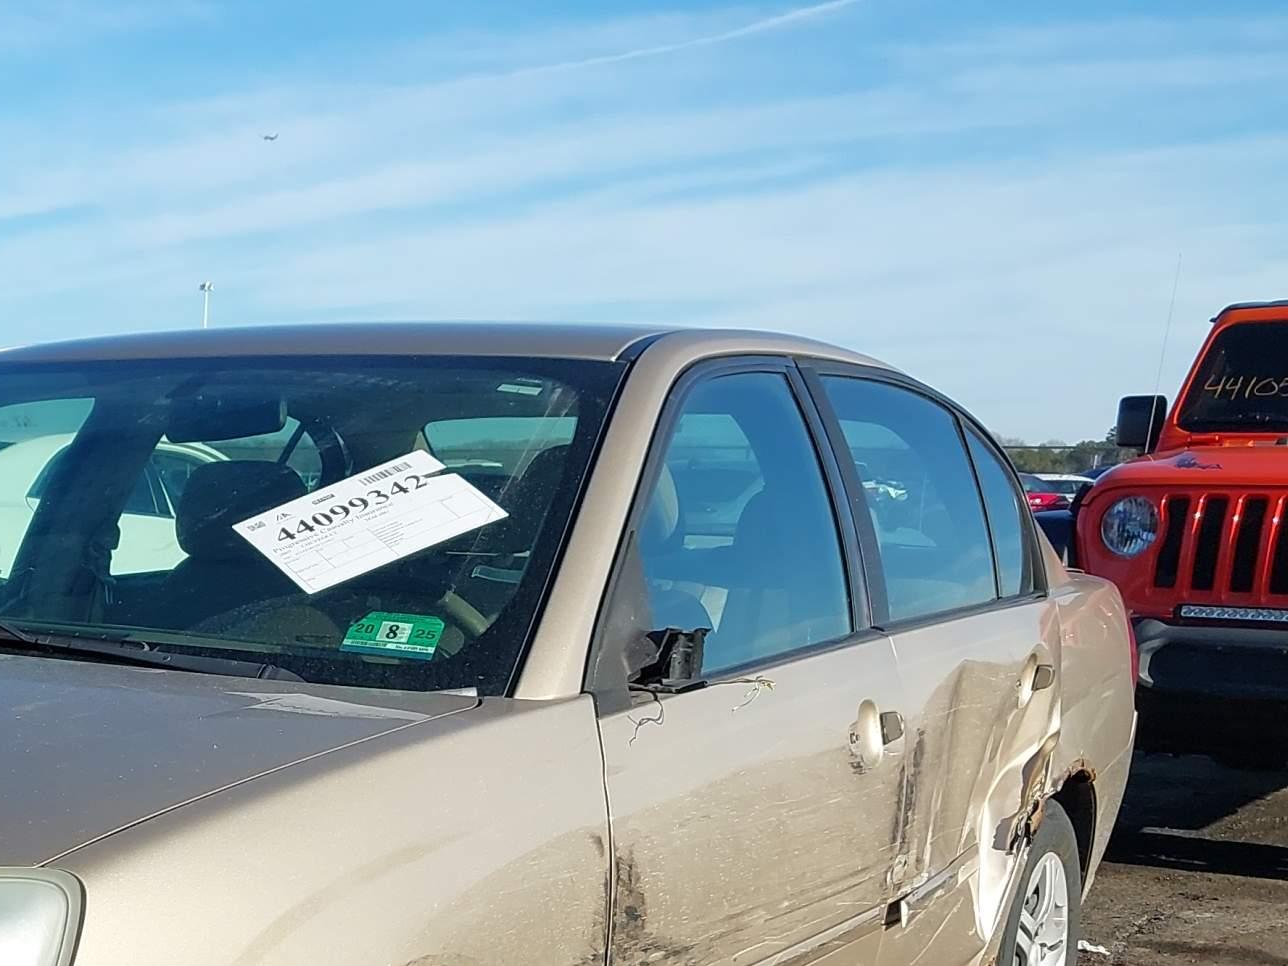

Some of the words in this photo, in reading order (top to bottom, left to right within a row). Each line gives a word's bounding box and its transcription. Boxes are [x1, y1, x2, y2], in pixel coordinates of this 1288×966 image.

[276, 473, 429, 544] 44099342
[355, 623, 375, 634] 20
[385, 624, 400, 640] 8
[414, 629, 436, 640] 25
